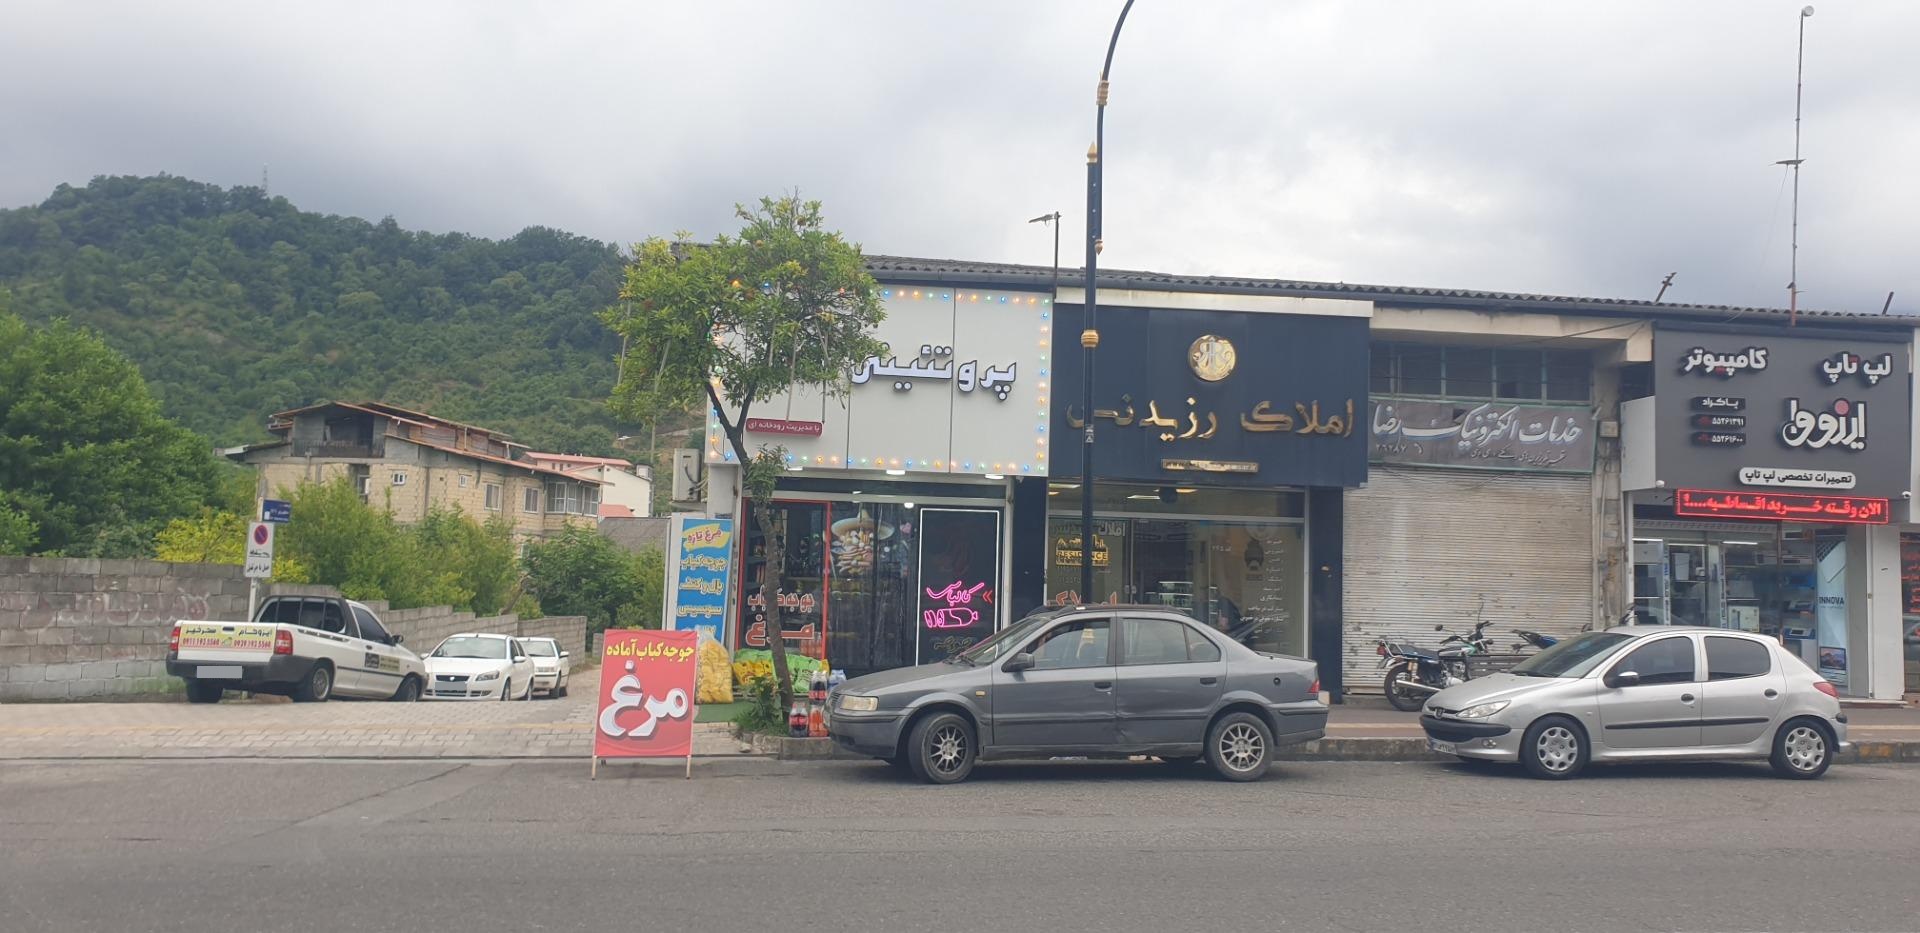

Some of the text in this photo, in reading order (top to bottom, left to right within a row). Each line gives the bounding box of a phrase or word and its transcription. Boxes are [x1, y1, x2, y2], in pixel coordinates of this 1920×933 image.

[1684, 348, 1768, 377] کامپیوتر
[1823, 353, 1892, 384] لپ تاپ
[1240, 398, 1354, 439] املاک
[1372, 403, 1402, 436] رضا
[1518, 415, 1583, 443] خدمات
[1745, 470, 1852, 485] تعمیرات تخصصی لپ تاپ
[1767, 499, 1823, 515] خرید
[1858, 501, 1881, 519] الان
[704, 526, 722, 544] مرغ
[606, 638, 695, 662] جوجه کباب آماده
[599, 660, 689, 737] مرغ
